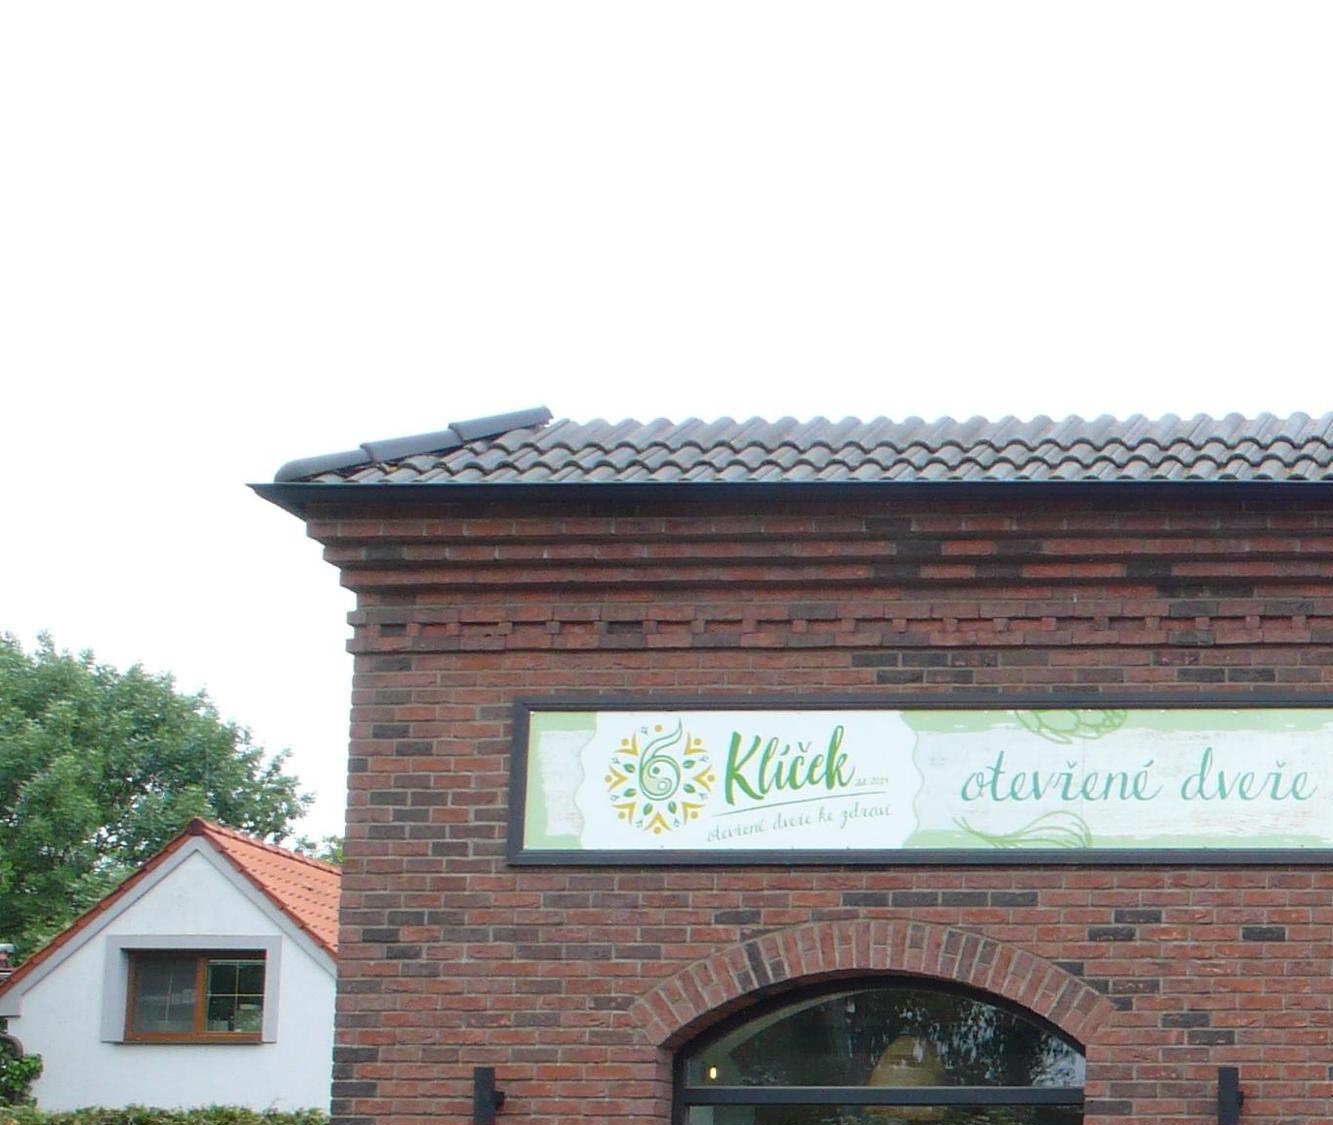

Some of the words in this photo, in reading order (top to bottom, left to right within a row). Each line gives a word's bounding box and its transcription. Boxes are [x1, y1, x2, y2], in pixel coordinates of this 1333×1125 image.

[725, 725, 855, 806] Klíček
[961, 750, 1164, 802] otevřené
[1180, 746, 1318, 802] dveře
